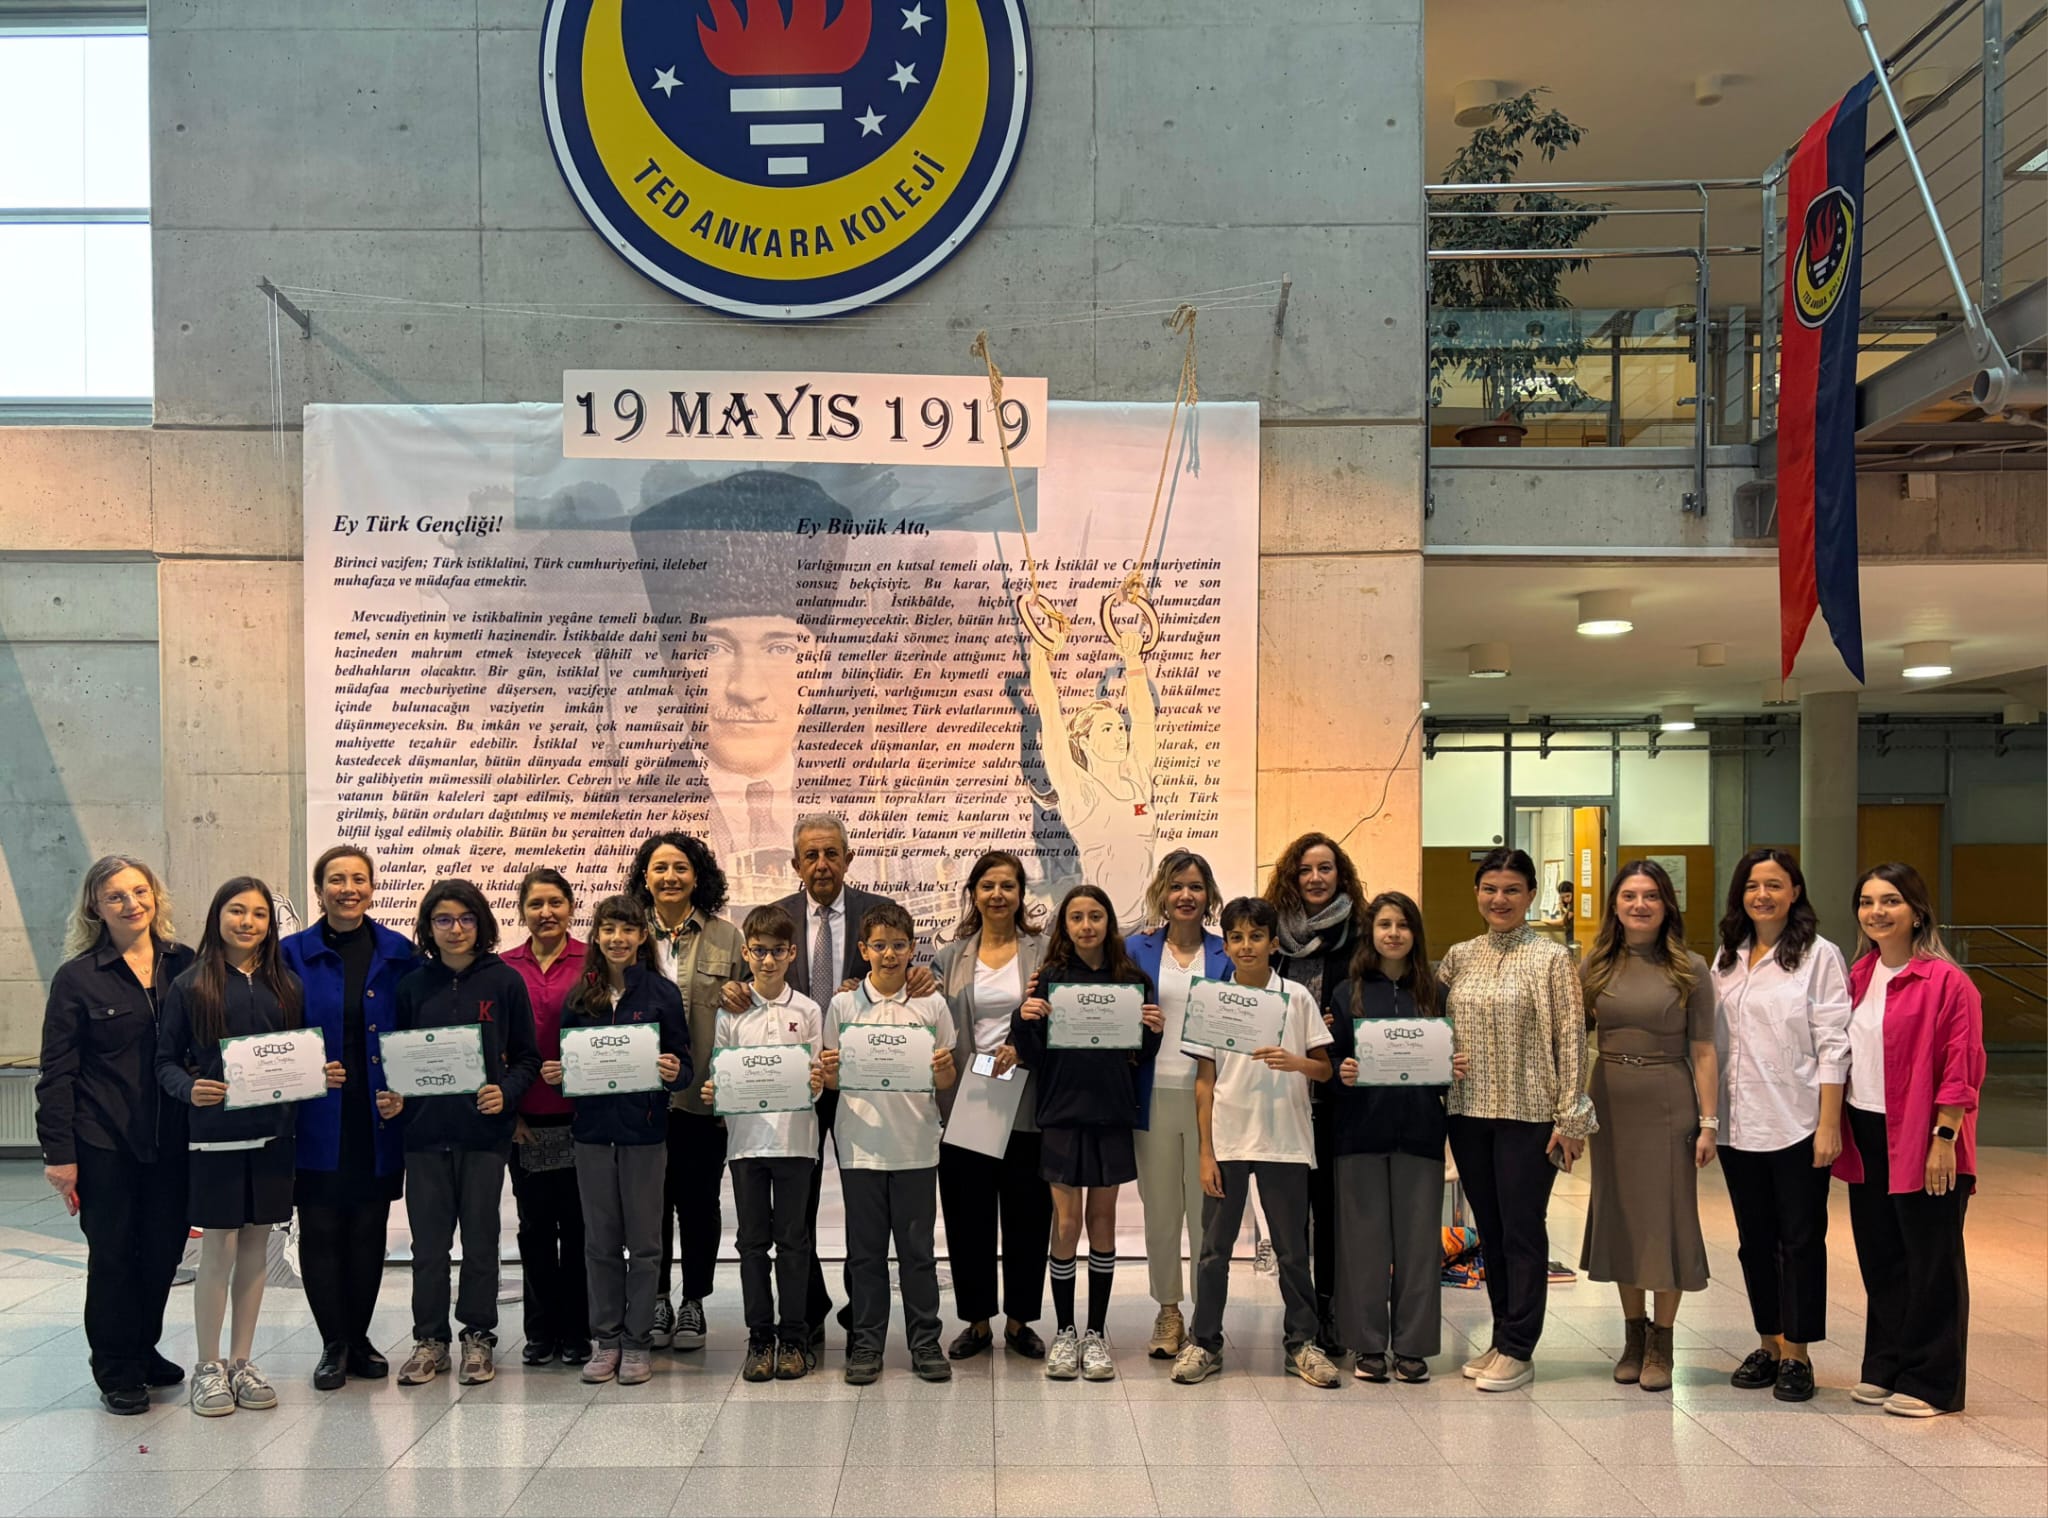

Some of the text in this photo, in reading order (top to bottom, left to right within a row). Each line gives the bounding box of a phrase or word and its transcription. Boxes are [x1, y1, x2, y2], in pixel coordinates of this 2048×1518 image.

[634, 157, 691, 220] TED
[691, 209, 834, 258] ANKARA
[576, 388, 647, 444] 19
[885, 396, 1033, 451] 1919
[333, 515, 503, 537] Ey Türk Gençliği!
[796, 517, 929, 539] Ey Büyük Ata,
[334, 555, 708, 573] Birinci vazifen; Türk istiklalini, Türk cumhuriyetini, ilelebet
[797, 559, 871, 575] Varlığımızın
[876, 561, 892, 571] en
[896, 558, 936, 571] kutsal
[939, 558, 978, 571] temeli
[982, 558, 1013, 574] olan,
[1055, 556, 1099, 571] İstiklâl
[1104, 560, 1117, 571] ve
[333, 573, 527, 590] muhafaza ve müdafaa etmektir.
[795, 580, 838, 589] sonsuz
[849, 576, 911, 592] bekçisiyiz.
[924, 576, 942, 589] Bu
[953, 576, 990, 592] karar,
[1147, 575, 1162, 588] ilk
[1175, 578, 1188, 588] ve
[1199, 578, 1221, 588] son
[796, 595, 869, 608] anlatımıdır.
[891, 593, 955, 611] İstikbâlde,
[978, 594, 1015, 610] hiçbir
[352, 610, 707, 627] Mevcudiyetinin ve istikbalinin yegâne temeli budur. Bu
[796, 613, 993, 629] döndürmeyecektir. Bizler, bütün
[334, 627, 707, 644] temel, senin en kıymetli hazinendir. İstikbalde dahi seni bu
[797, 635, 810, 644] ve
[815, 631, 899, 644] ruhumuzdaki
[903, 631, 949, 644] sönmez
[954, 631, 989, 647] inanç
[1160, 629, 1221, 645] kurduğun
[334, 645, 709, 663] hazineden mahrum etmek isteyecek dâhilî ve haricî
[796, 650, 832, 666] güçlü
[838, 649, 888, 662] temeller
[894, 649, 947, 662] üzerinde
[953, 649, 1006, 665] attığımız
[1200, 648, 1221, 661] her
[334, 663, 709, 682] bedhahların olacaktır. Bir gün, istiklal ve cumhuriyeti
[797, 664, 1221, 683] atılım bilinçlidir. En kıymetli olan, İstiklâl ve
[334, 681, 708, 700] müdafaa mecburiyetine düşersen, vazifeye atılmak için
[797, 683, 1221, 701] Cumhuriyeti, varlığımızın esası bükülmez
[334, 699, 709, 718] içinde bulunacağın vaziyetin imkân ve şeraitini
[334, 718, 709, 735] düşünmeyeceksin. Bu imkân ve şerait, çok namüsait bir
[1204, 774, 1220, 786] bu
[336, 806, 711, 825] girilmiş, bütün orduları dağıtılmış ve memleketin her köşesi
[1134, 803, 1147, 816] K
[912, 826, 1219, 839] Vatanın ve milletin iman
[873, 880, 910, 894] büyük
[913, 879, 949, 892] Ata'sı
[479, 1000, 495, 1021] K
[633, 1011, 643, 1020] K
[789, 1022, 798, 1032] K
